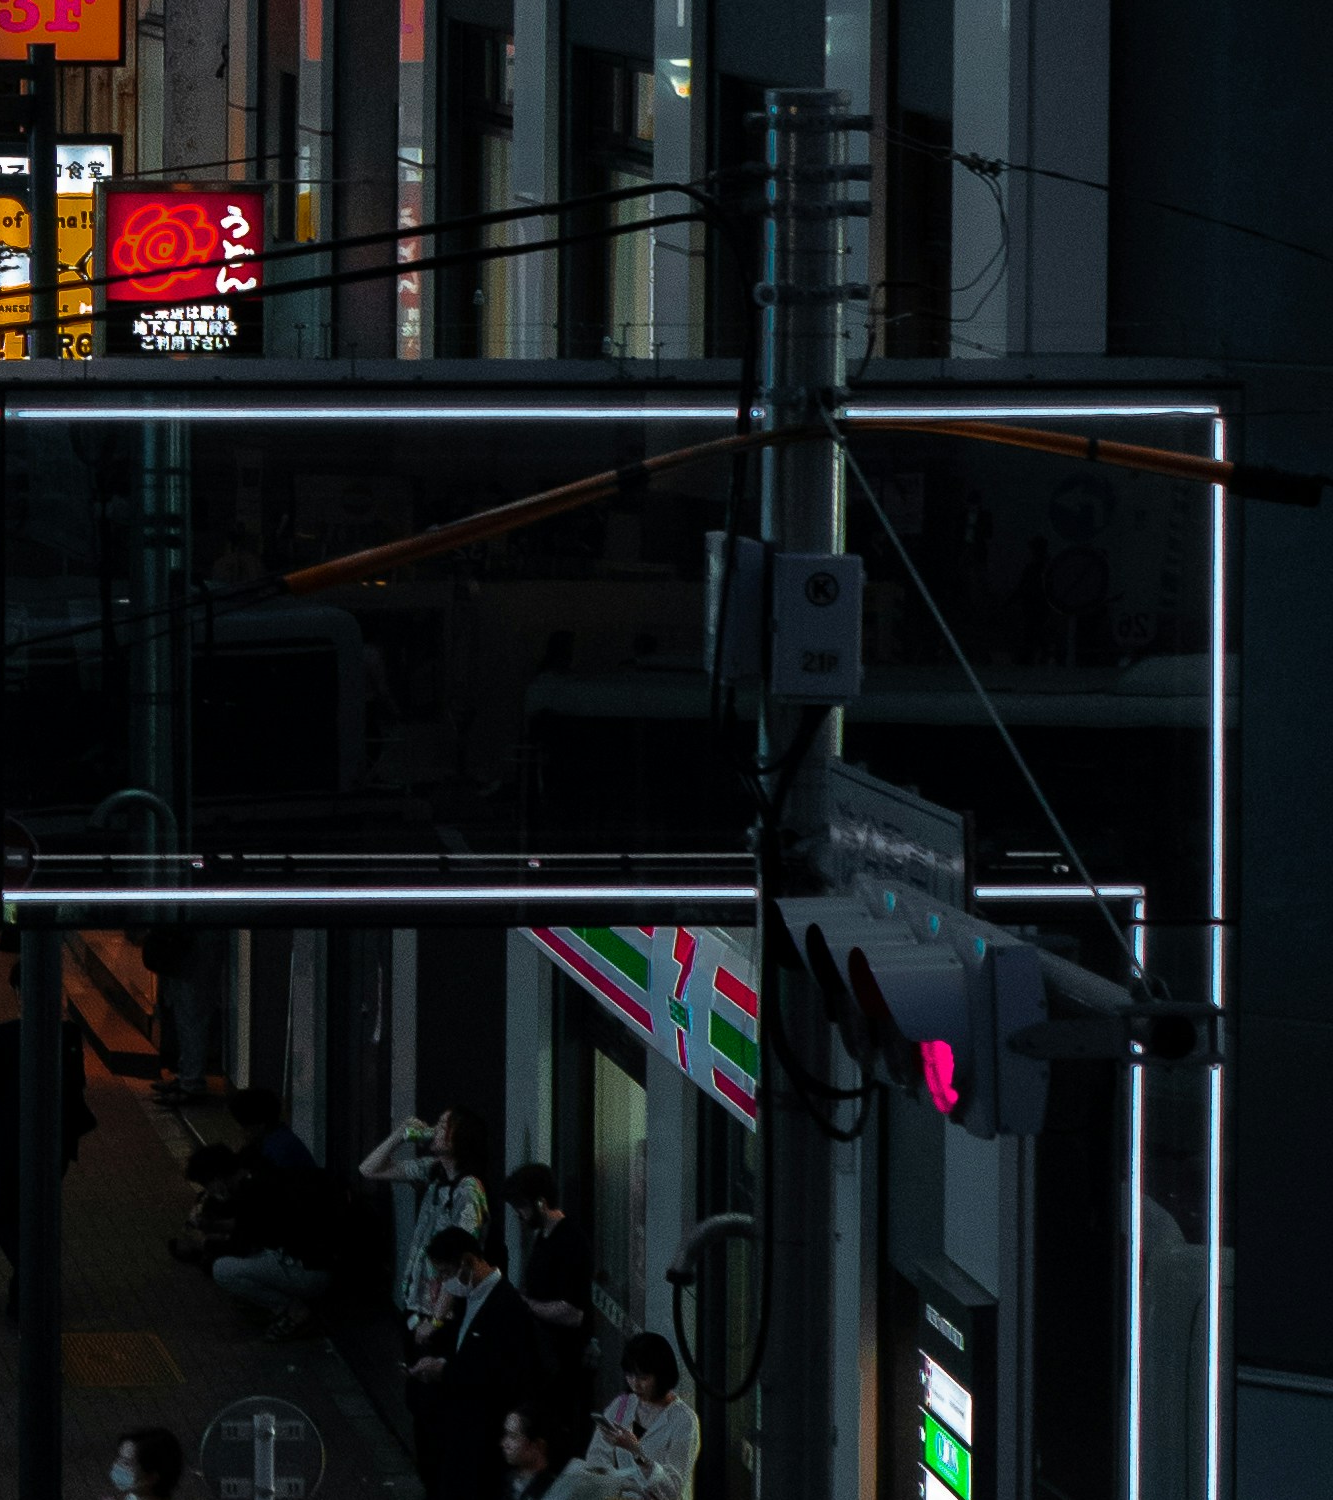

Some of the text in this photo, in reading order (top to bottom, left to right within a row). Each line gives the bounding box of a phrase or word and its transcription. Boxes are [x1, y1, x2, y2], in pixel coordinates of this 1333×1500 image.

[2, 211, 25, 229] of
[214, 205, 258, 294] うどん
